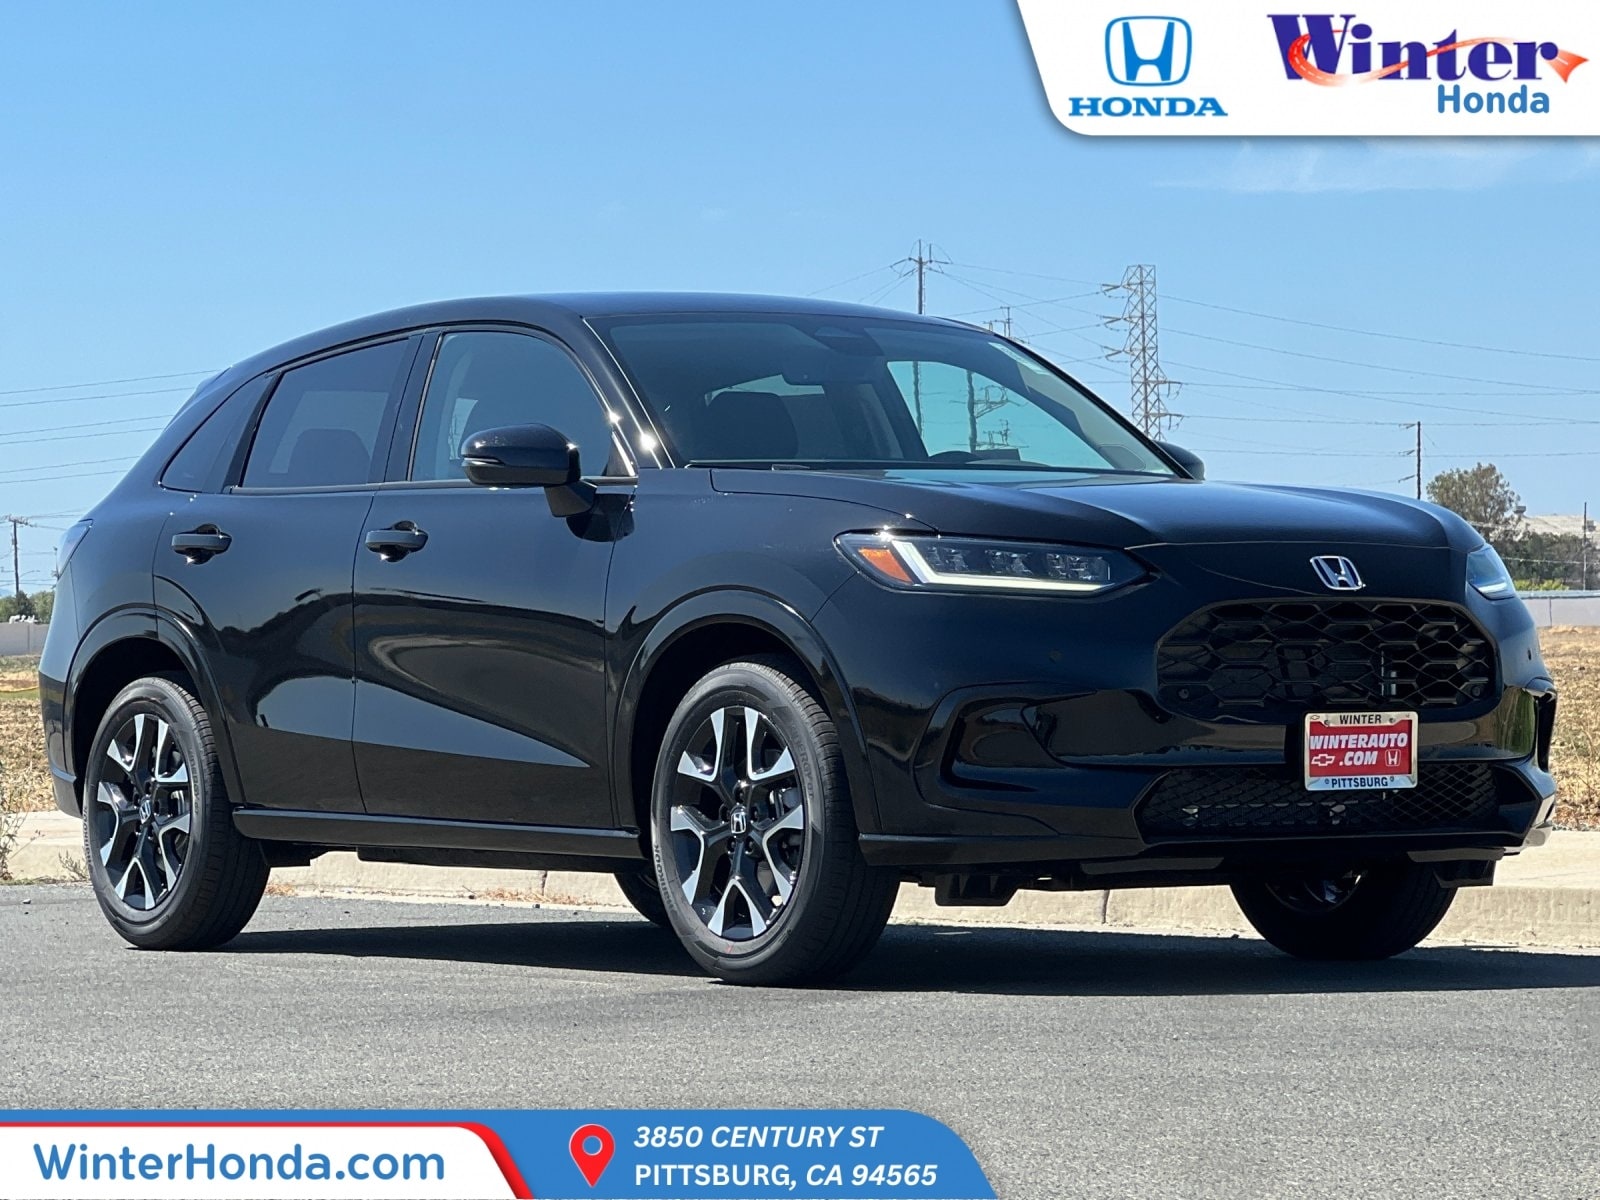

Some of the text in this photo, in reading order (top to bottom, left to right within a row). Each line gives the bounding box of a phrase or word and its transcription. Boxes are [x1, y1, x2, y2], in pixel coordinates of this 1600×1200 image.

[1339, 714, 1382, 725] WINTER
[1309, 733, 1408, 749] WINTERAUTO
[1338, 750, 1378, 766] .COM
[1331, 776, 1389, 788] PITTSBURG
